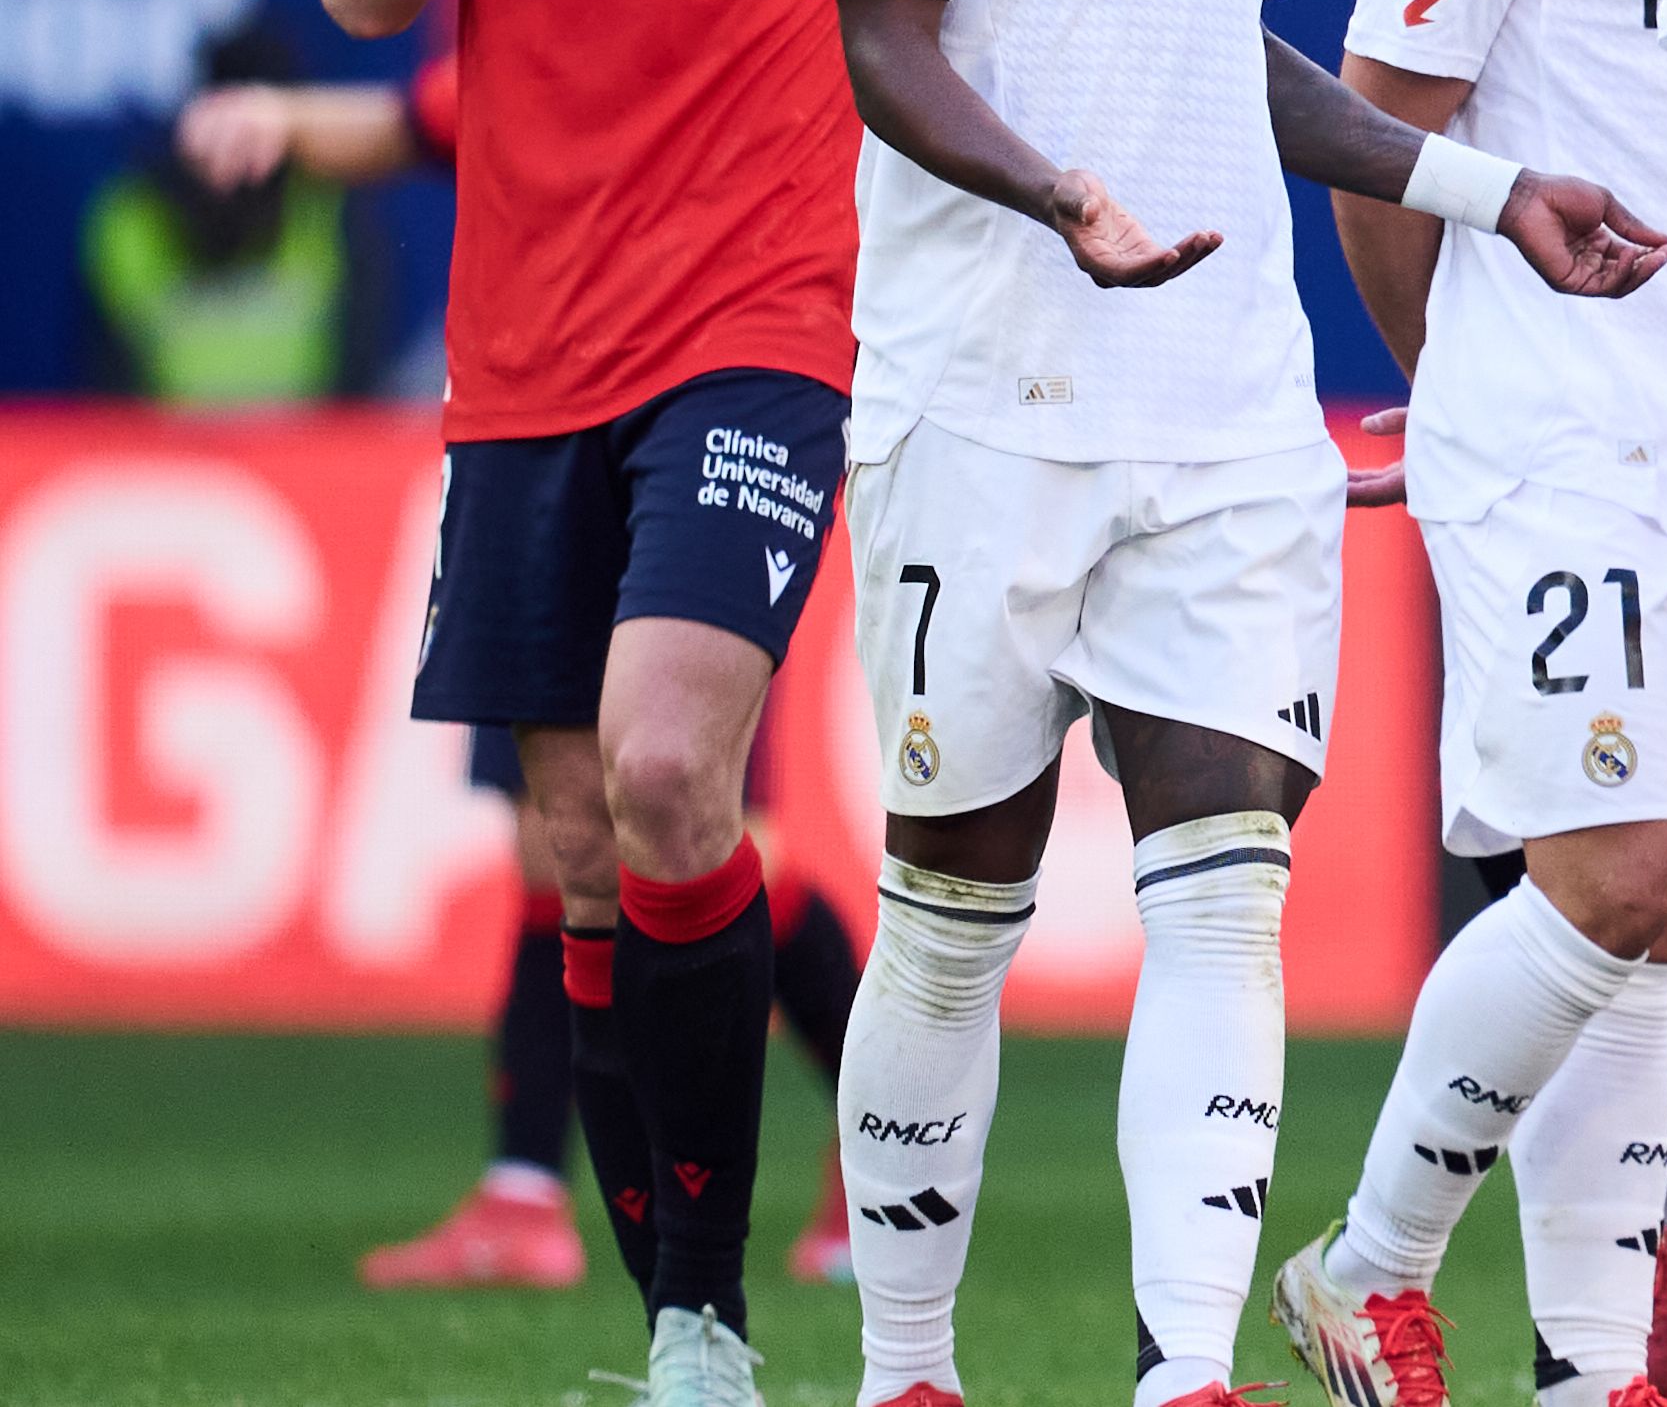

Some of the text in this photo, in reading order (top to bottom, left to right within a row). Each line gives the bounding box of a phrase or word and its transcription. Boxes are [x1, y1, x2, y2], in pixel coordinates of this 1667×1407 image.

[705, 427, 789, 468] Clínica
[702, 454, 825, 515] Universidad
[698, 480, 815, 540] de Navarra
[898, 564, 941, 696] 7
[1526, 568, 1646, 696] 21
[1204, 1094, 1279, 1132] RMC
[1447, 1075, 1531, 1115] RMC
[859, 1112, 967, 1146] RMCF
